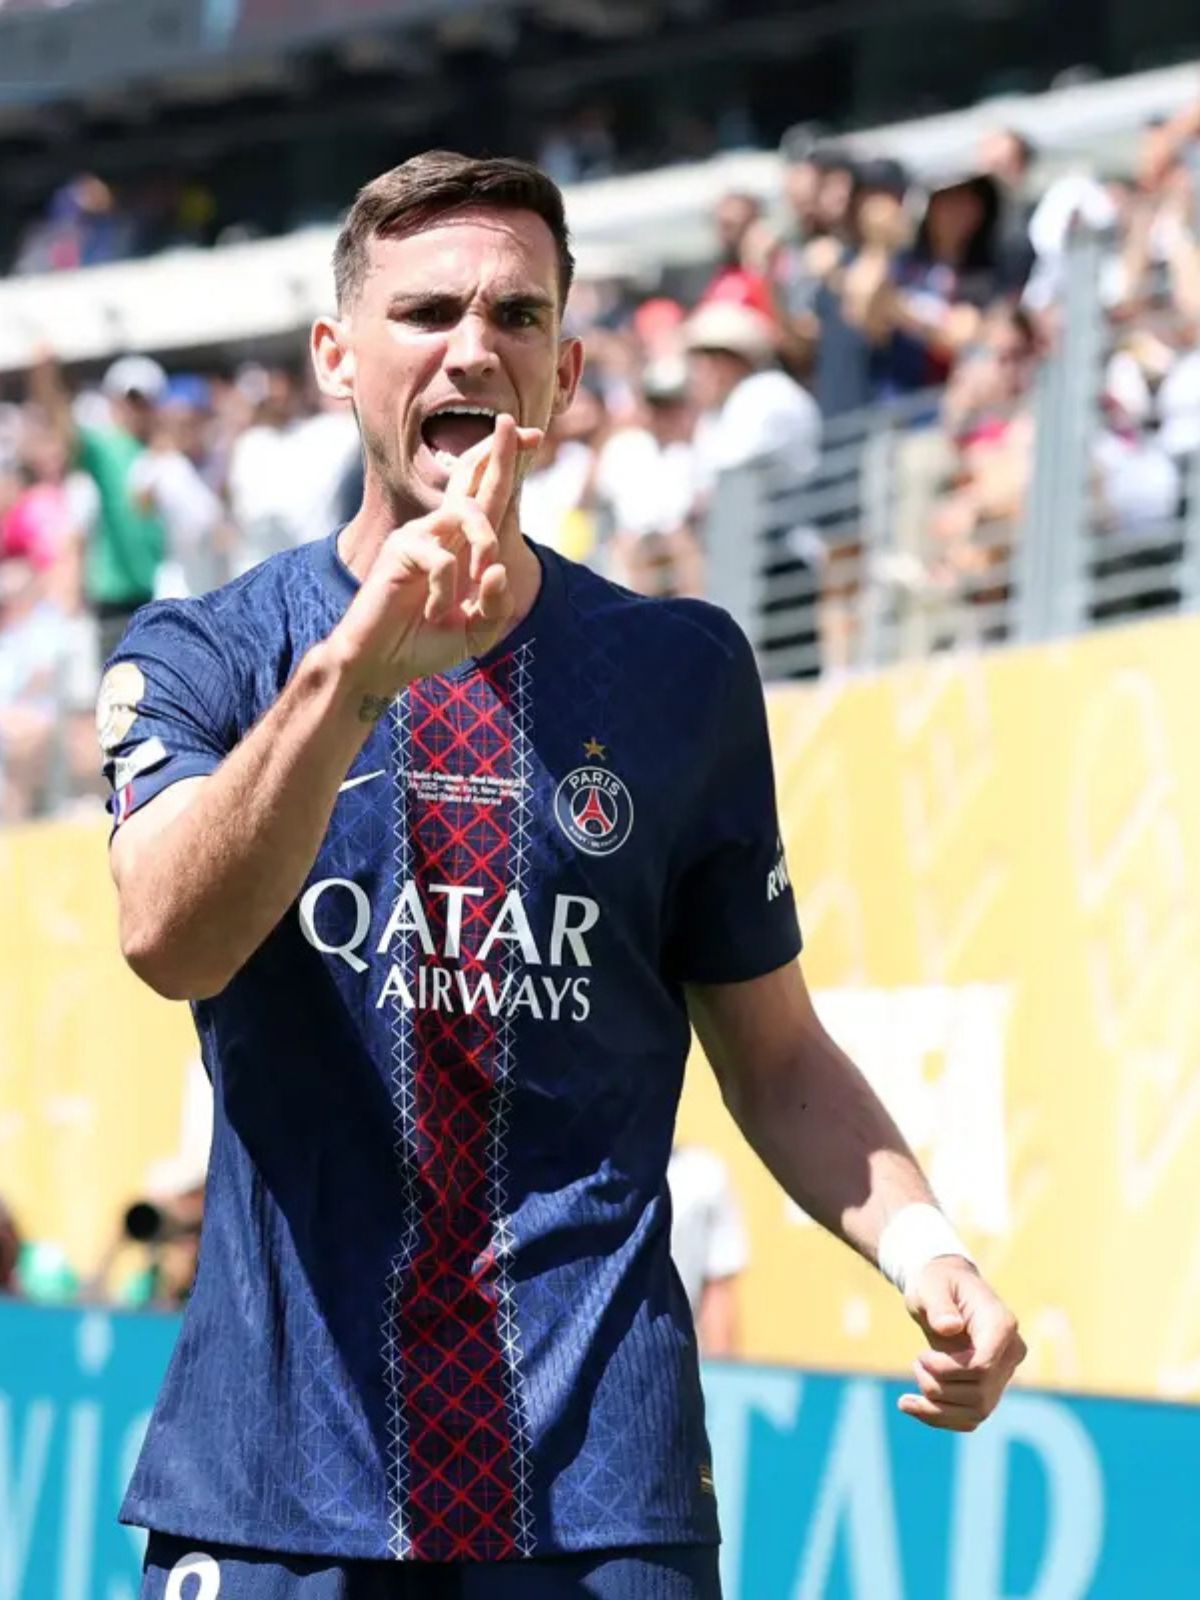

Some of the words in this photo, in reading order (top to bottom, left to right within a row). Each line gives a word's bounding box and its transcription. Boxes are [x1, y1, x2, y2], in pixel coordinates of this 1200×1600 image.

[568, 771, 620, 796] PARIS
[299, 877, 601, 974] QATAR
[375, 963, 591, 1023] AIRWAYS
